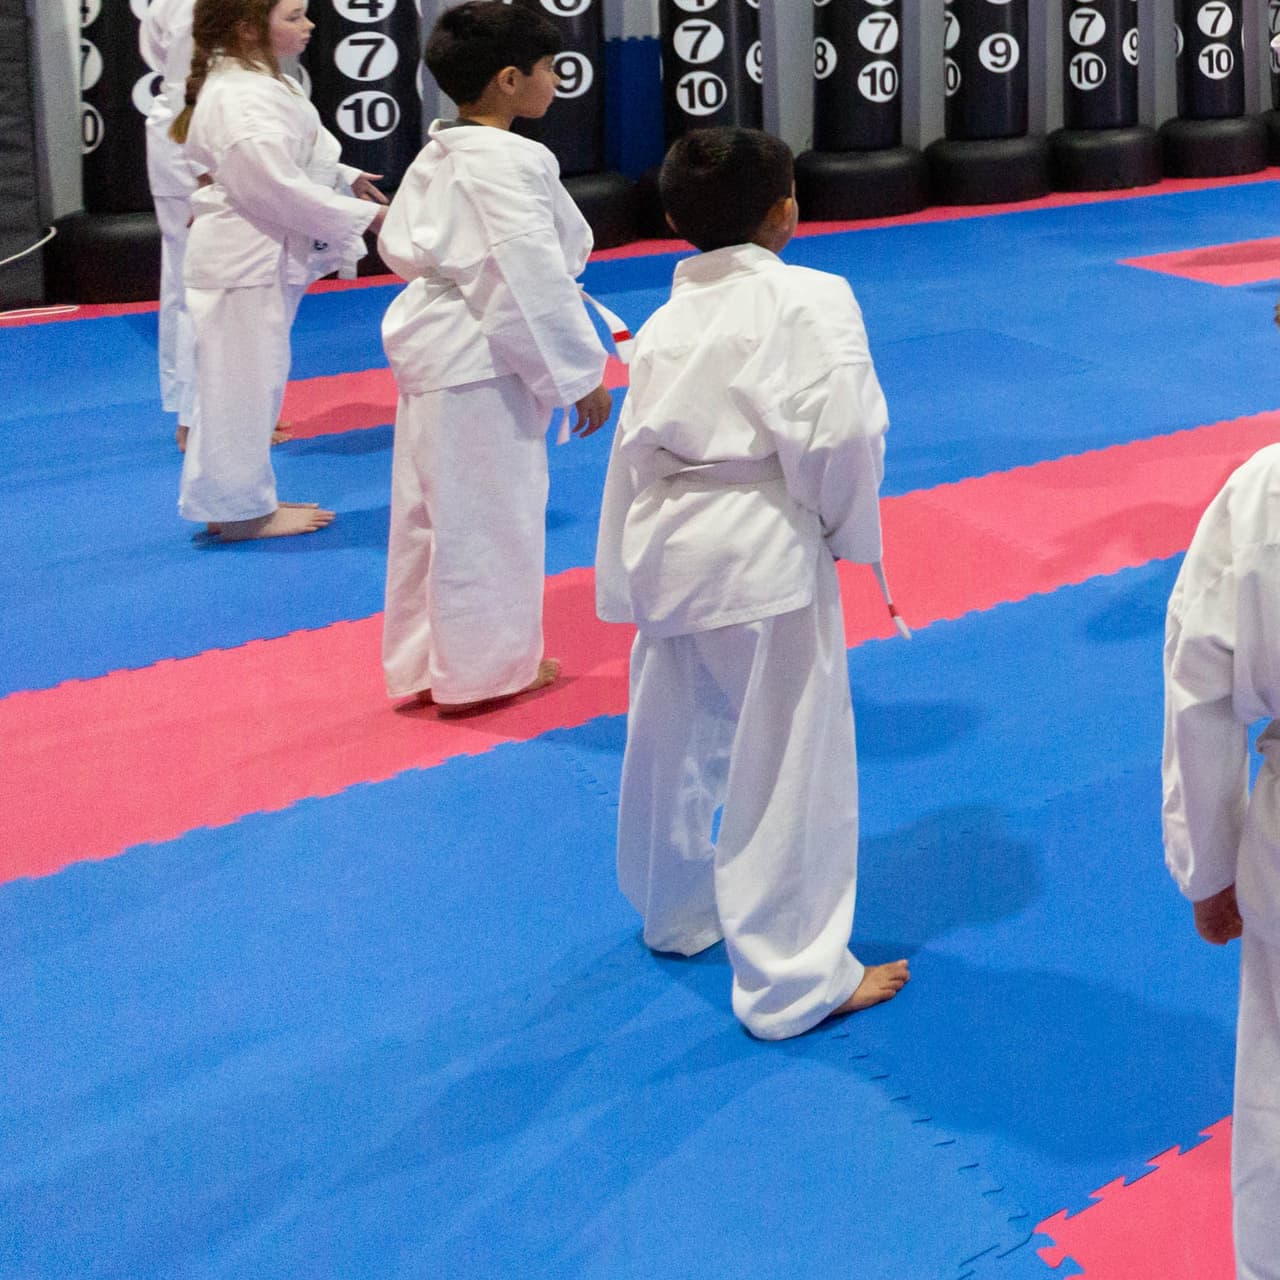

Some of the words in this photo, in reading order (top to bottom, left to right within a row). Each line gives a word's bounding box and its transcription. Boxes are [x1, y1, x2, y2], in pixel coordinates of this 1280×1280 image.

[868, 18, 892, 50] 7
[1075, 13, 1096, 43] 7
[1205, 6, 1225, 34] 7
[349, 38, 385, 78] 7
[682, 25, 711, 60] 7
[815, 41, 828, 75] 8
[988, 37, 1013, 68] 9
[554, 55, 583, 94] 9
[1071, 57, 1103, 85] 10
[1201, 48, 1232, 74] 10
[680, 78, 723, 109] 10
[862, 66, 897, 97] 10
[342, 97, 395, 134] 10
